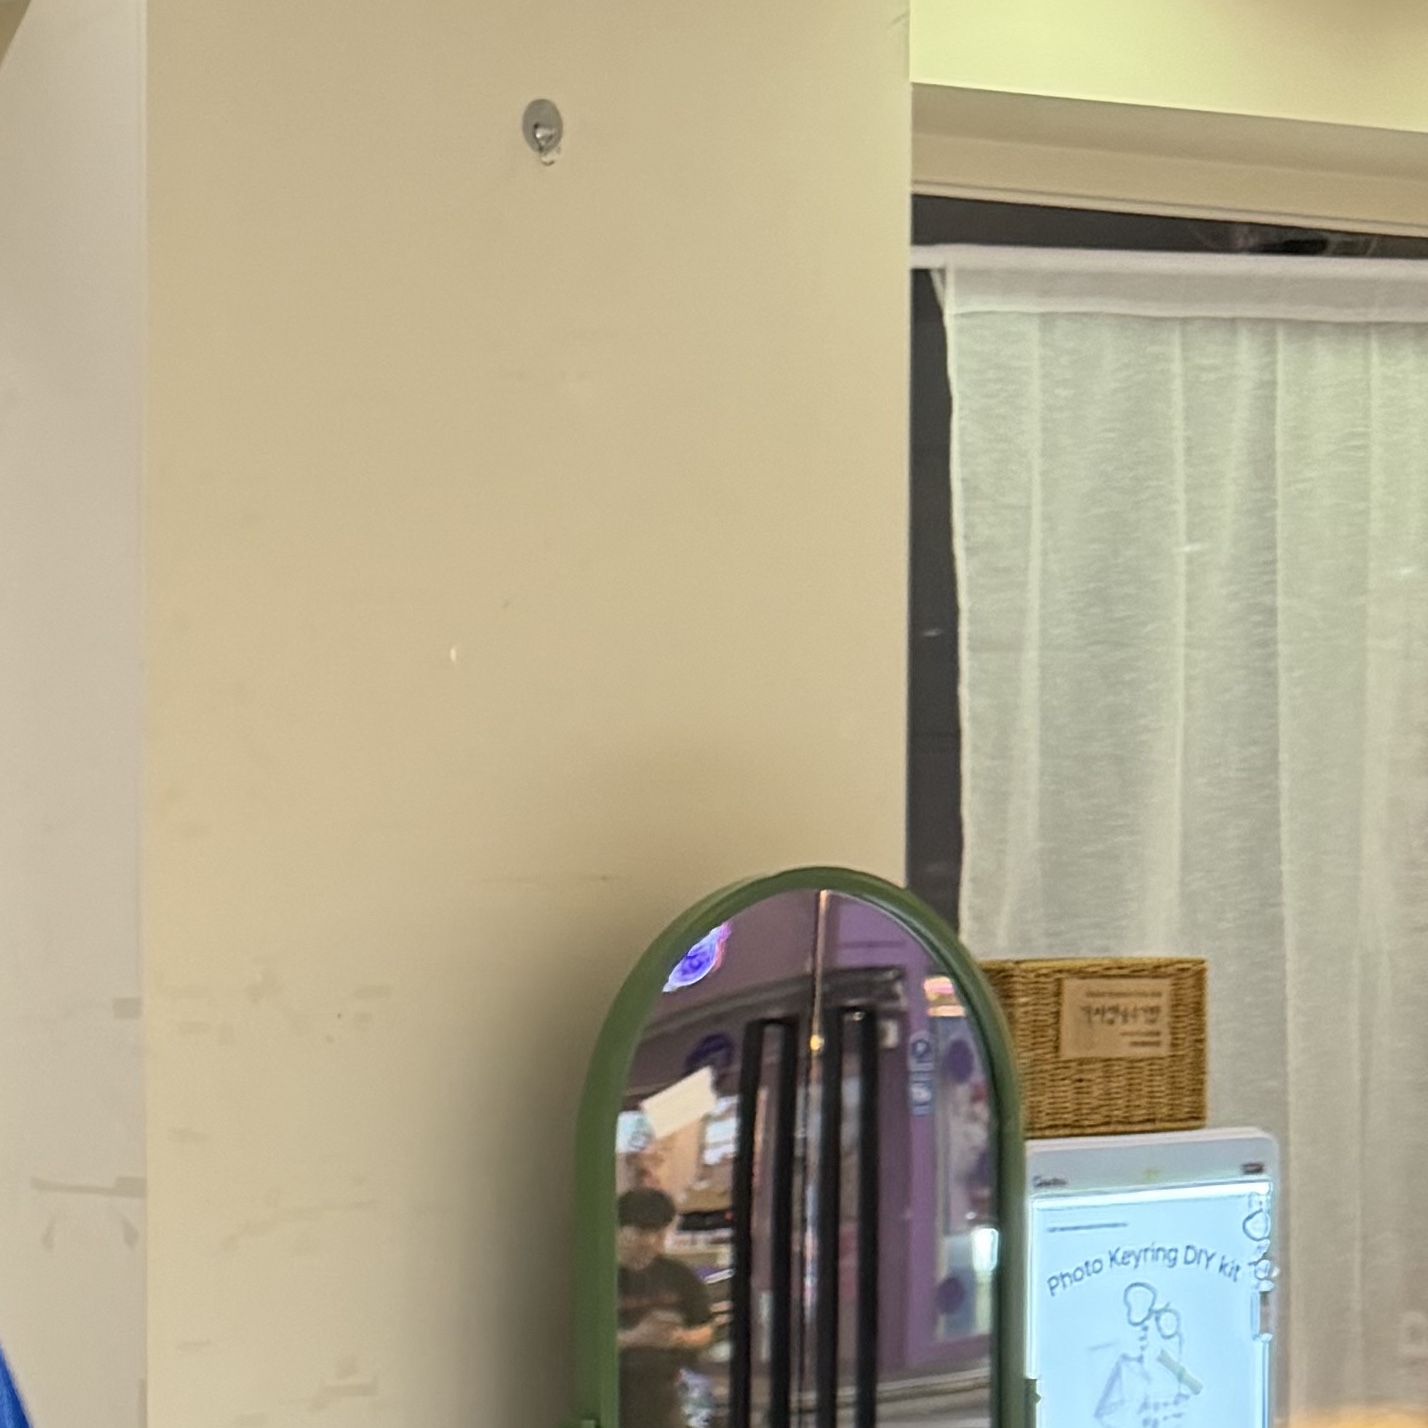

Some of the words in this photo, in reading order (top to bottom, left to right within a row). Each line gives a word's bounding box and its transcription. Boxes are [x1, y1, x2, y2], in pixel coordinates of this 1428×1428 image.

[1047, 1258, 1103, 1296] Photo
[1109, 1241, 1178, 1269] Keyring
[1183, 1245, 1216, 1268] DIY
[1218, 1256, 1242, 1283] kit
